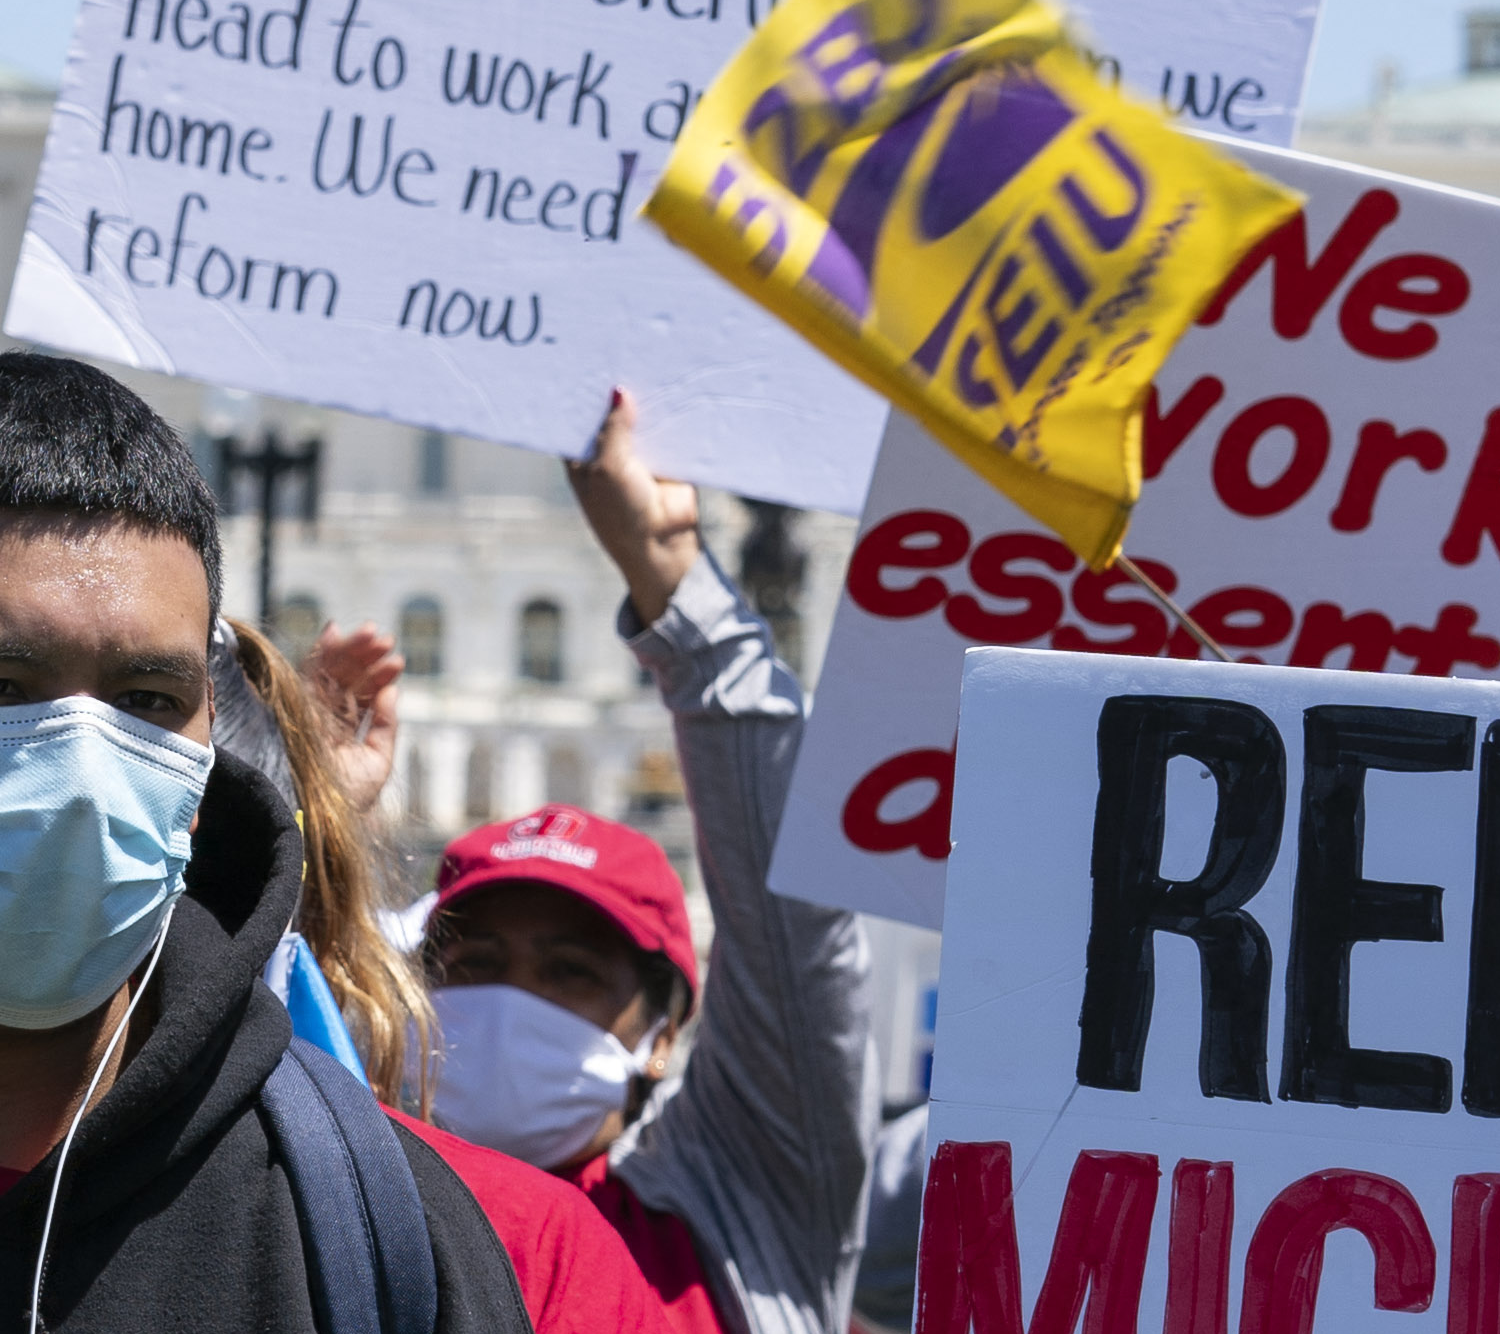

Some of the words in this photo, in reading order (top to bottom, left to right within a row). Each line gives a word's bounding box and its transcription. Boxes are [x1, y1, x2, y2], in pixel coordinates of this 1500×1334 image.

[100, 54, 287, 182] home.
[312, 108, 438, 208] We
[462, 151, 640, 242] need
[441, 45, 613, 141] work
[1160, 67, 1266, 132] we
[83, 193, 339, 319] reform
[400, 278, 558, 347] now.
